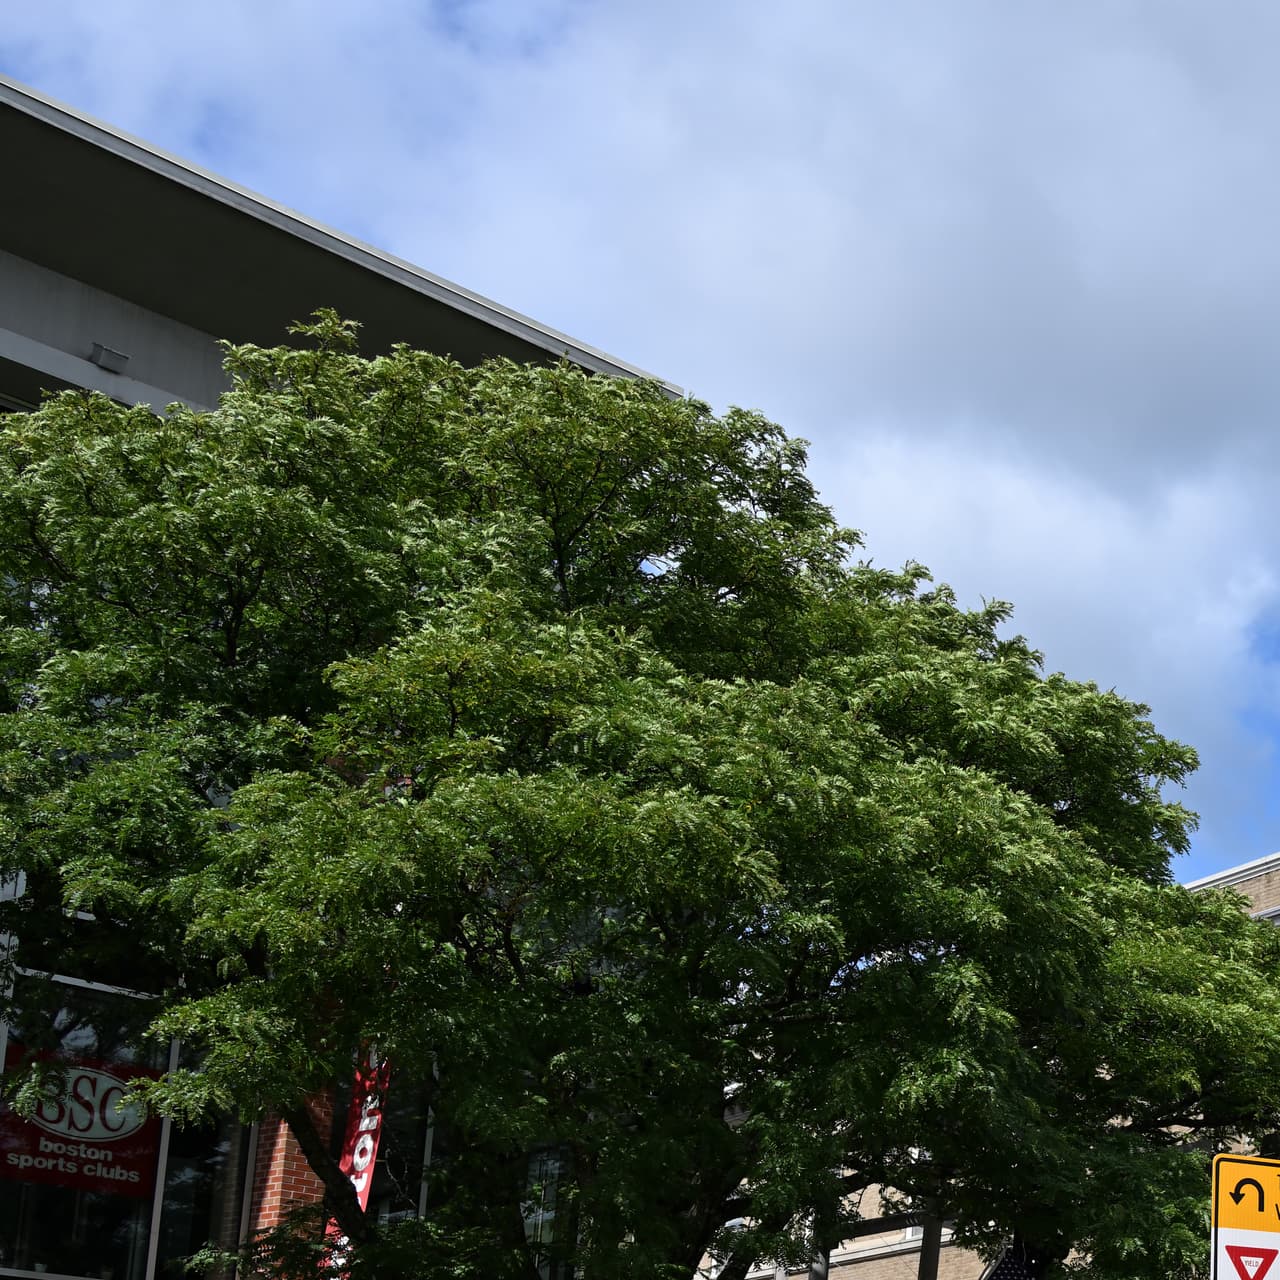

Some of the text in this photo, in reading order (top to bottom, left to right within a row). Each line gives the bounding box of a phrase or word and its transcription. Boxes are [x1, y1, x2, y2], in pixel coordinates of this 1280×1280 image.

[39, 1138, 112, 1162] boston
[7, 1152, 141, 1183] sports clubs
[1244, 1258, 1259, 1268] YIELD
